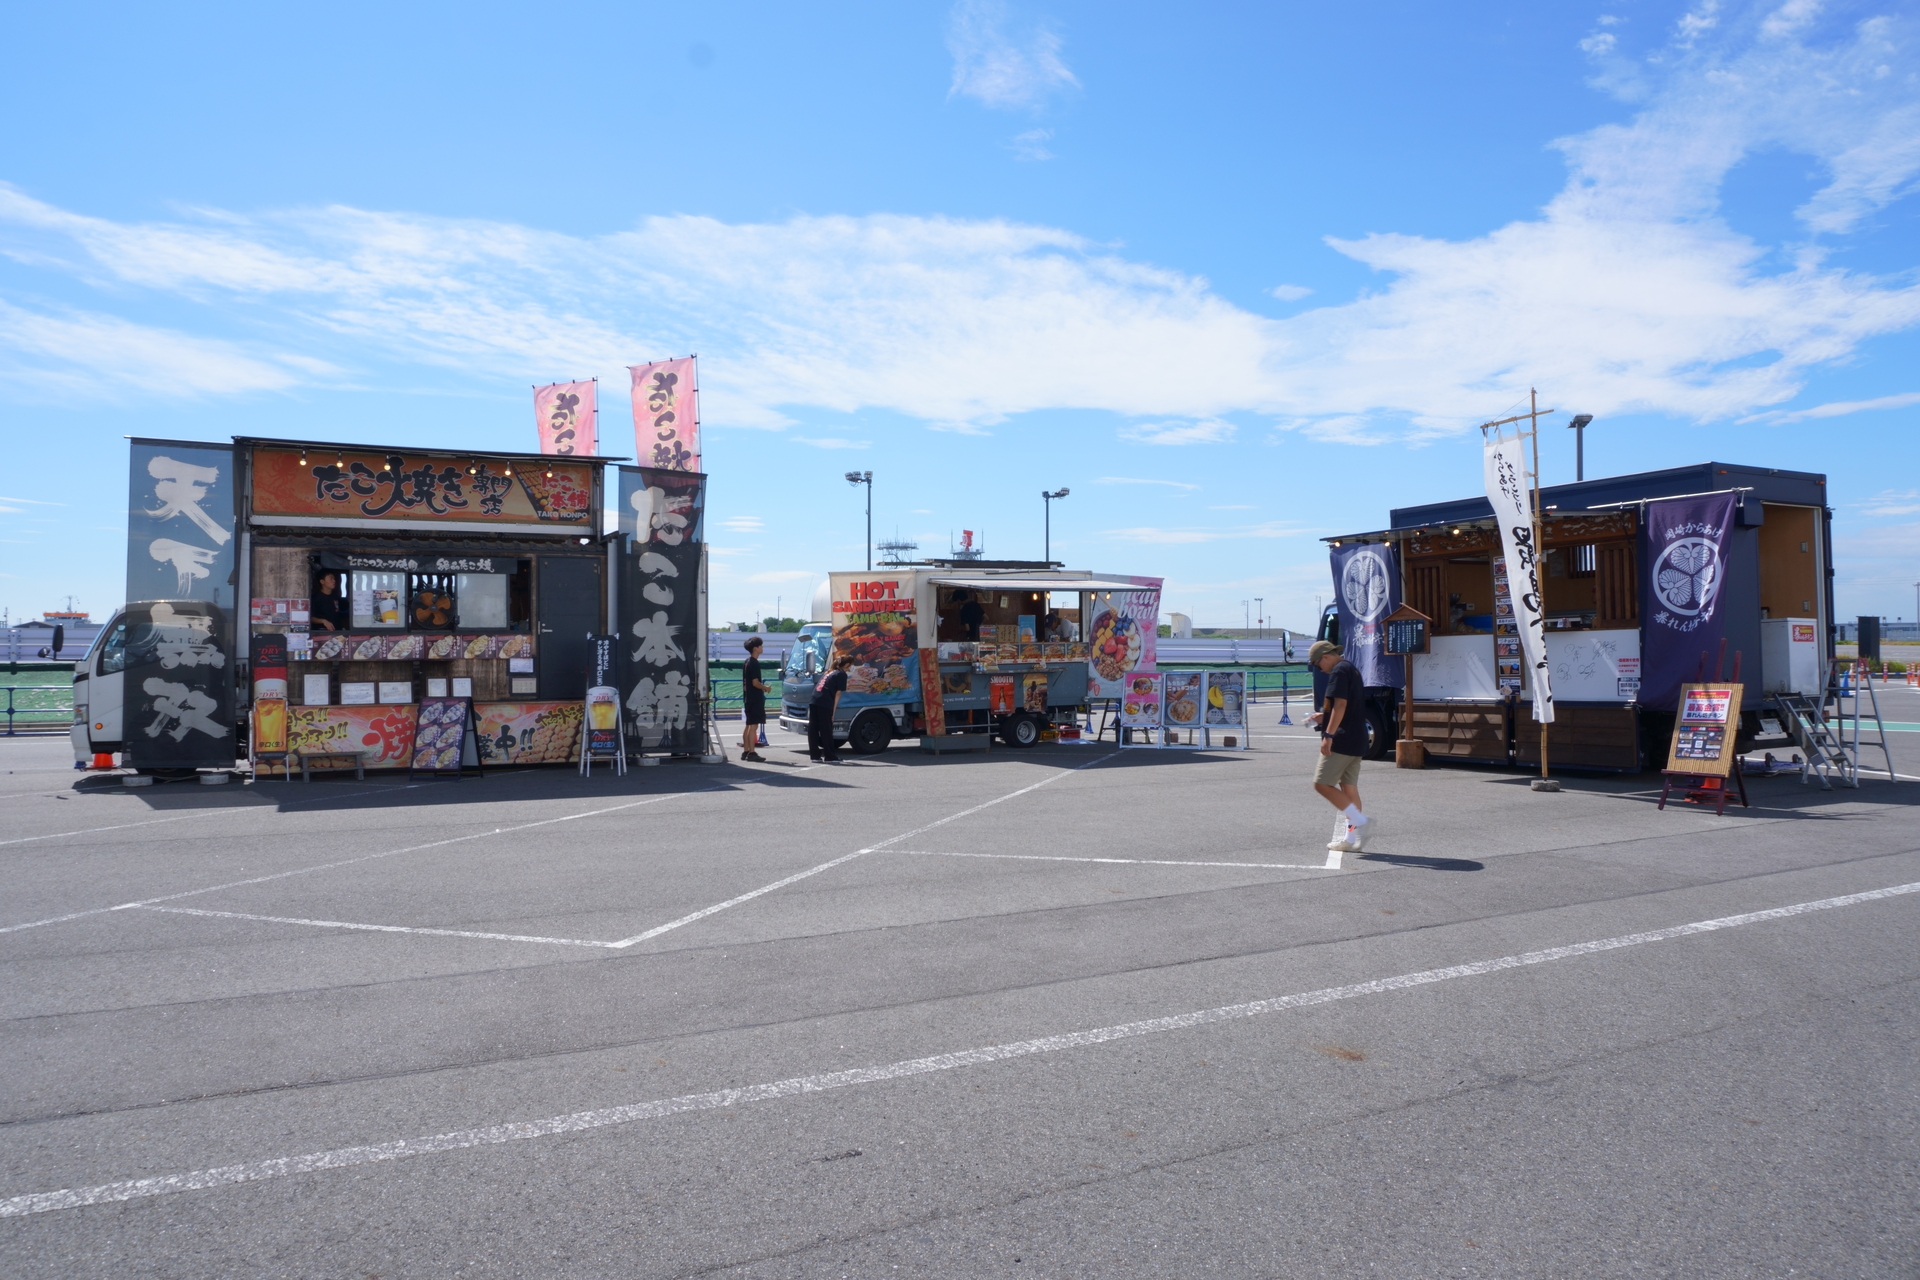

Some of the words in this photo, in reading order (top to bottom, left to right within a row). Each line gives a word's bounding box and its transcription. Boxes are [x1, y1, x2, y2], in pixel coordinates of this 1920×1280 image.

[537, 510, 559, 519] TAKO
[560, 511, 588, 520] HONPO
[1665, 522, 1723, 540] 岡崎からあげ
[850, 581, 898, 600] HOT
[832, 599, 914, 613] SANDWICH
[1117, 599, 1159, 620] bowl
[990, 675, 1014, 684] SMOOTH
